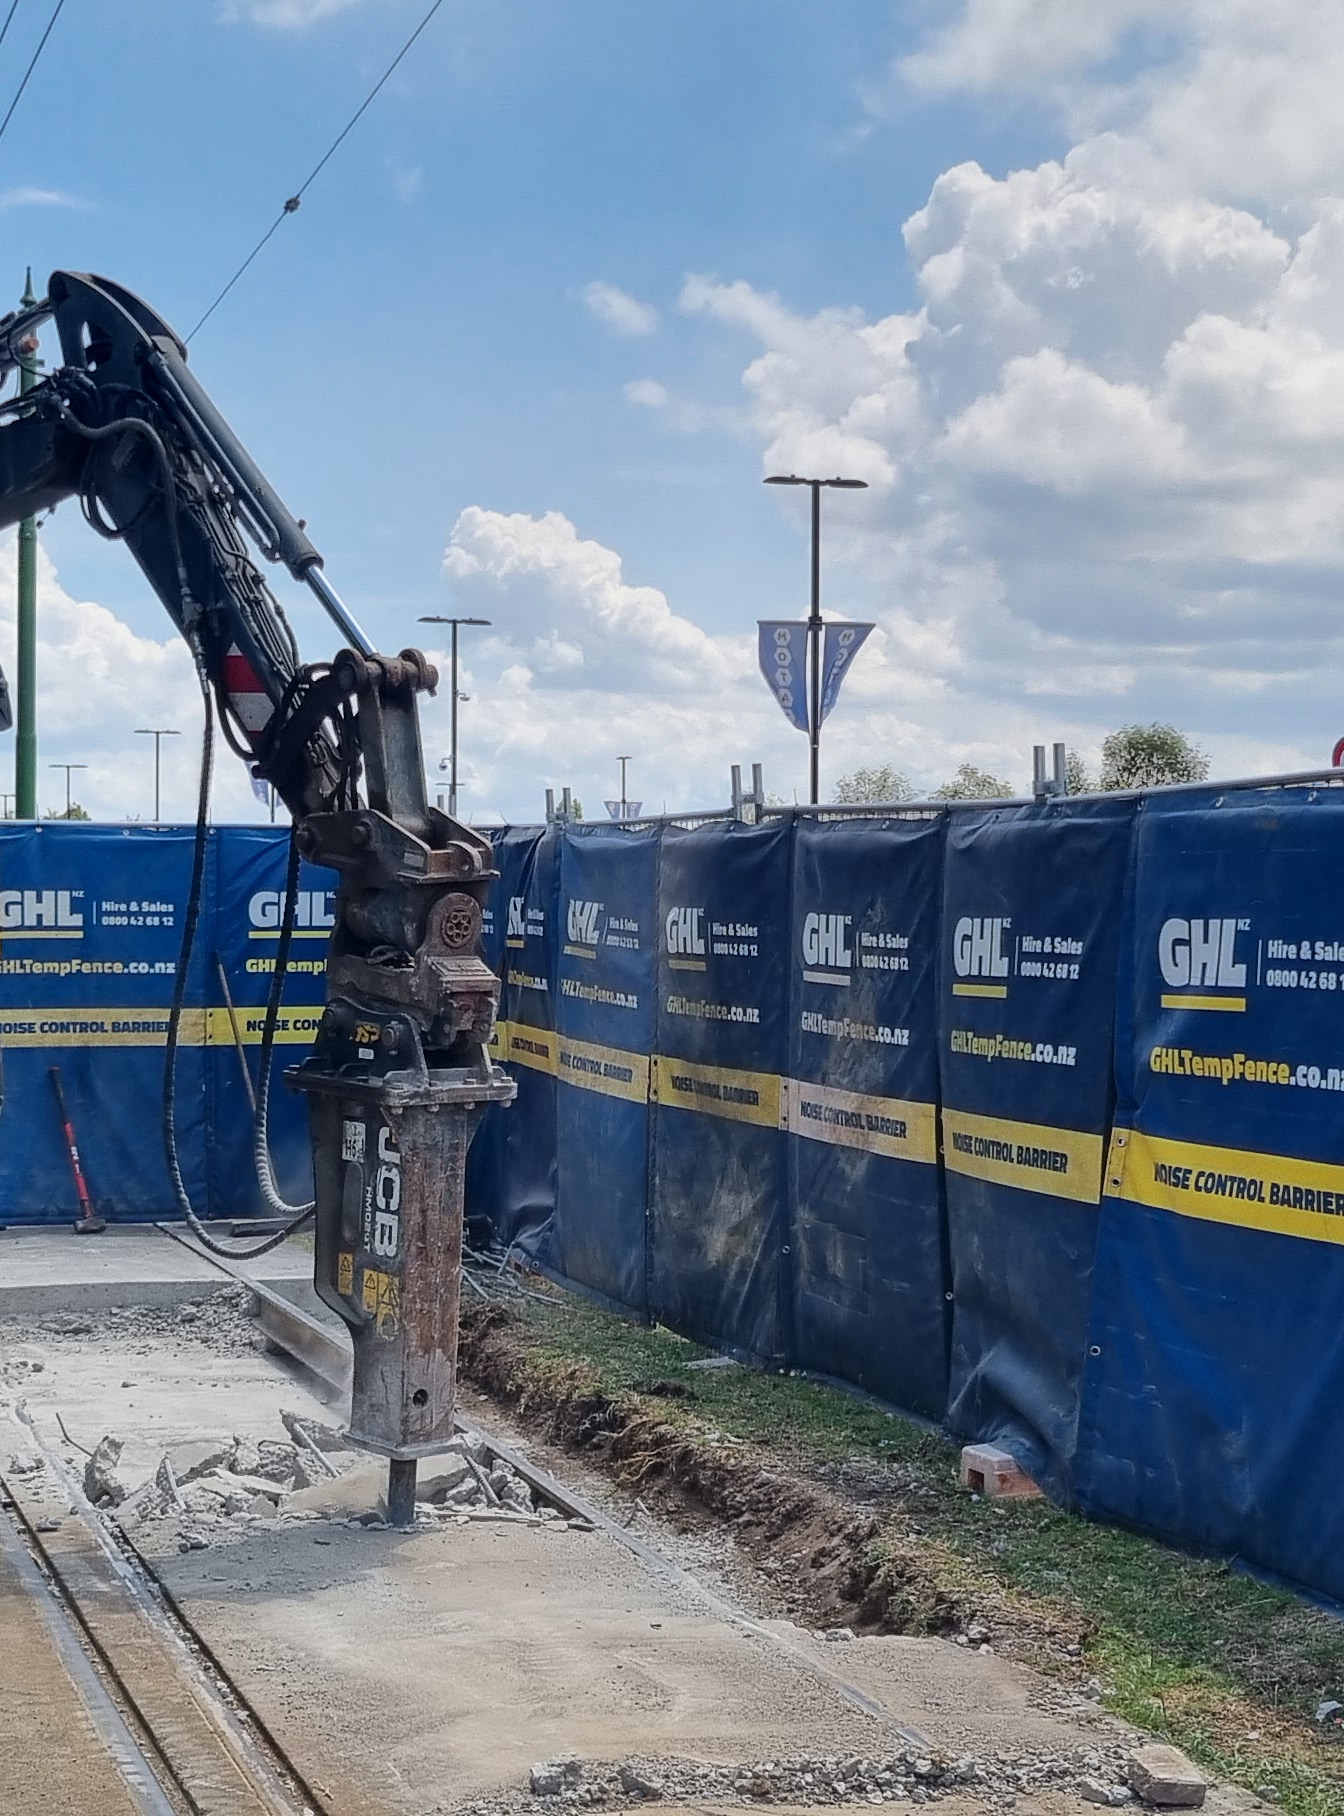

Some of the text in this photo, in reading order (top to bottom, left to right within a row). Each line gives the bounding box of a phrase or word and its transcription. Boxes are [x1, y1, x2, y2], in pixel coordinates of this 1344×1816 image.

[72, 890, 85, 898] NZ
[101, 901, 175, 913] Hire & Sales
[101, 916, 128, 926] 0800
[130, 916, 145, 926] 42
[162, 916, 175, 926] 12
[665, 906, 706, 955] GHL
[736, 923, 758, 938] Sales
[802, 912, 851, 968] GHL
[861, 932, 908, 949] Hire & Sales
[954, 917, 1009, 978] GHL
[1022, 935, 1083, 956] Hire & Sales
[1267, 939, 1297, 960] Hire
[1301, 940, 1312, 960] &
[1159, 917, 1251, 988] GHL NZ
[1020, 961, 1079, 980] 0800 42 68 12
[1266, 969, 1298, 989] 0800
[1300, 970, 1317, 990] 42
[1319, 971, 1338, 990] 68
[39, 1021, 108, 1034] CONTROL
[246, 1019, 290, 1032] NOSE
[801, 1011, 909, 1046] GHLTempFence.co.nz
[951, 1029, 1077, 1067] GHLTempFence.co.nz
[800, 1101, 907, 1139] NOISE CONTROL BARRIER
[974, 1137, 1015, 1165] CONTROL
[1016, 1143, 1068, 1174] BARRIER
[374, 1126, 401, 1257] JCB
[1154, 1162, 1193, 1190] NOISE
[1194, 1170, 1266, 1203] CONTROL
